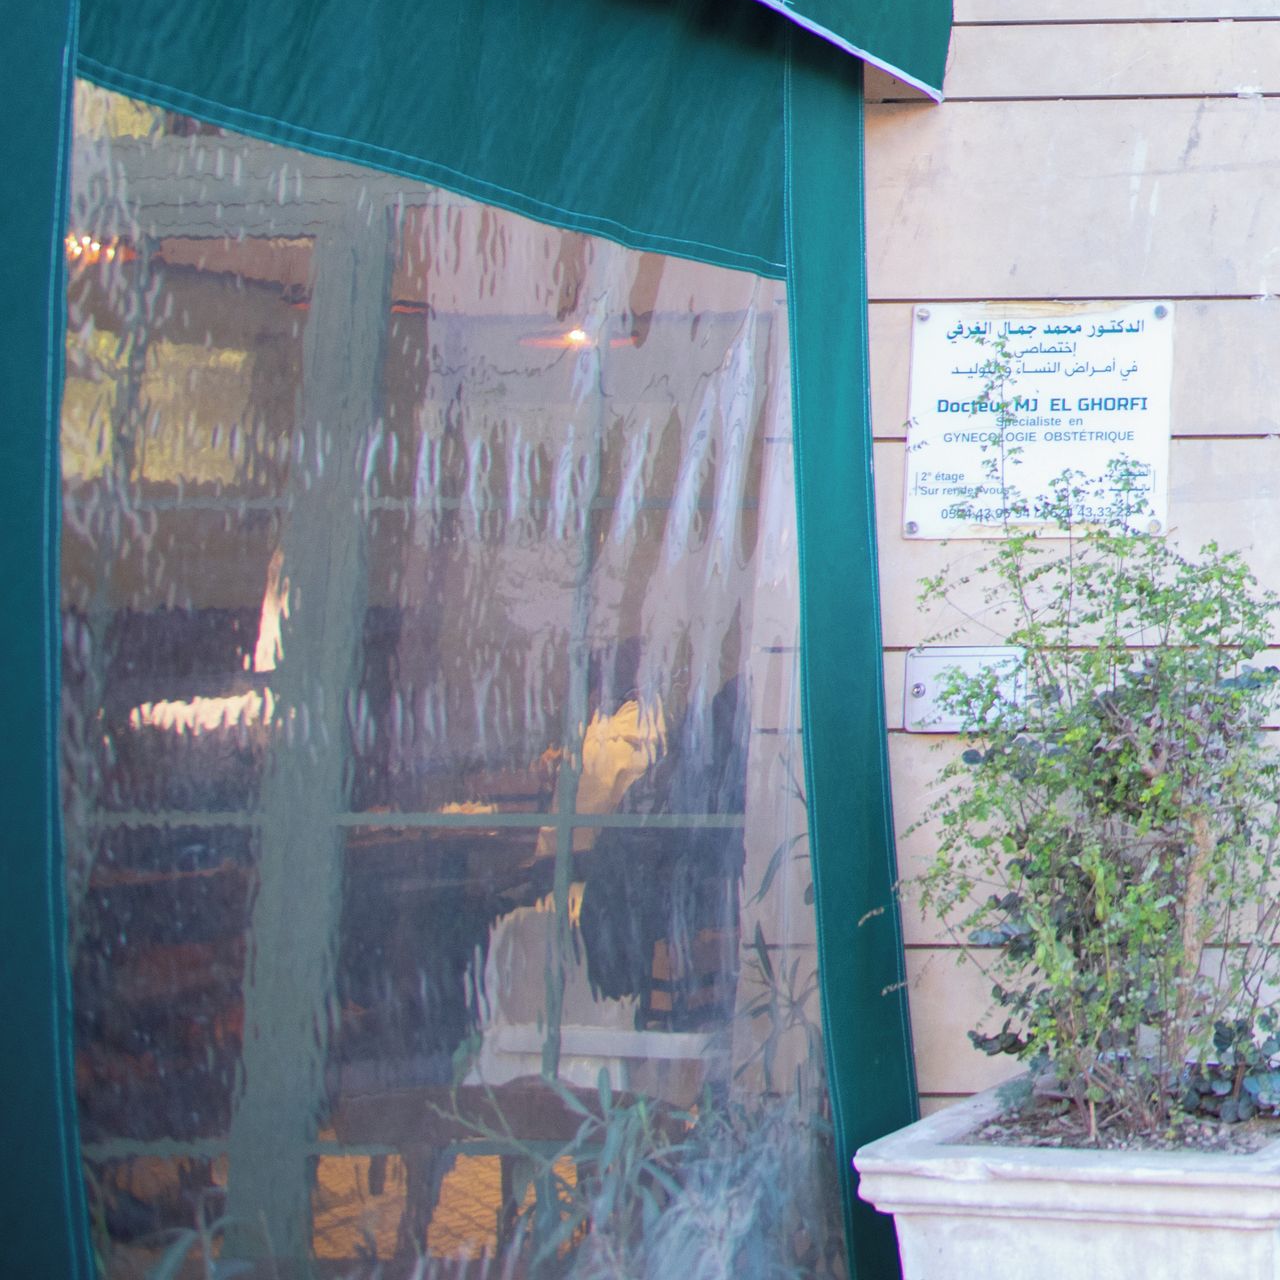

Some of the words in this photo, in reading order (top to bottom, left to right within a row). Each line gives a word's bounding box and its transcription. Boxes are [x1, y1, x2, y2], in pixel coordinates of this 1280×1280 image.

[1043, 321, 1082, 336] محمد
[1120, 365, 1138, 384] في
[937, 399, 1007, 414] Docteu
[1015, 398, 1039, 412] MJ
[1049, 397, 1072, 412] EL
[1077, 397, 1148, 413] GHORFI
[1068, 417, 1084, 427] en
[1043, 428, 1135, 443] OBSTÉTRIQUE
[935, 470, 965, 483] étage
[920, 486, 939, 496] Sur
